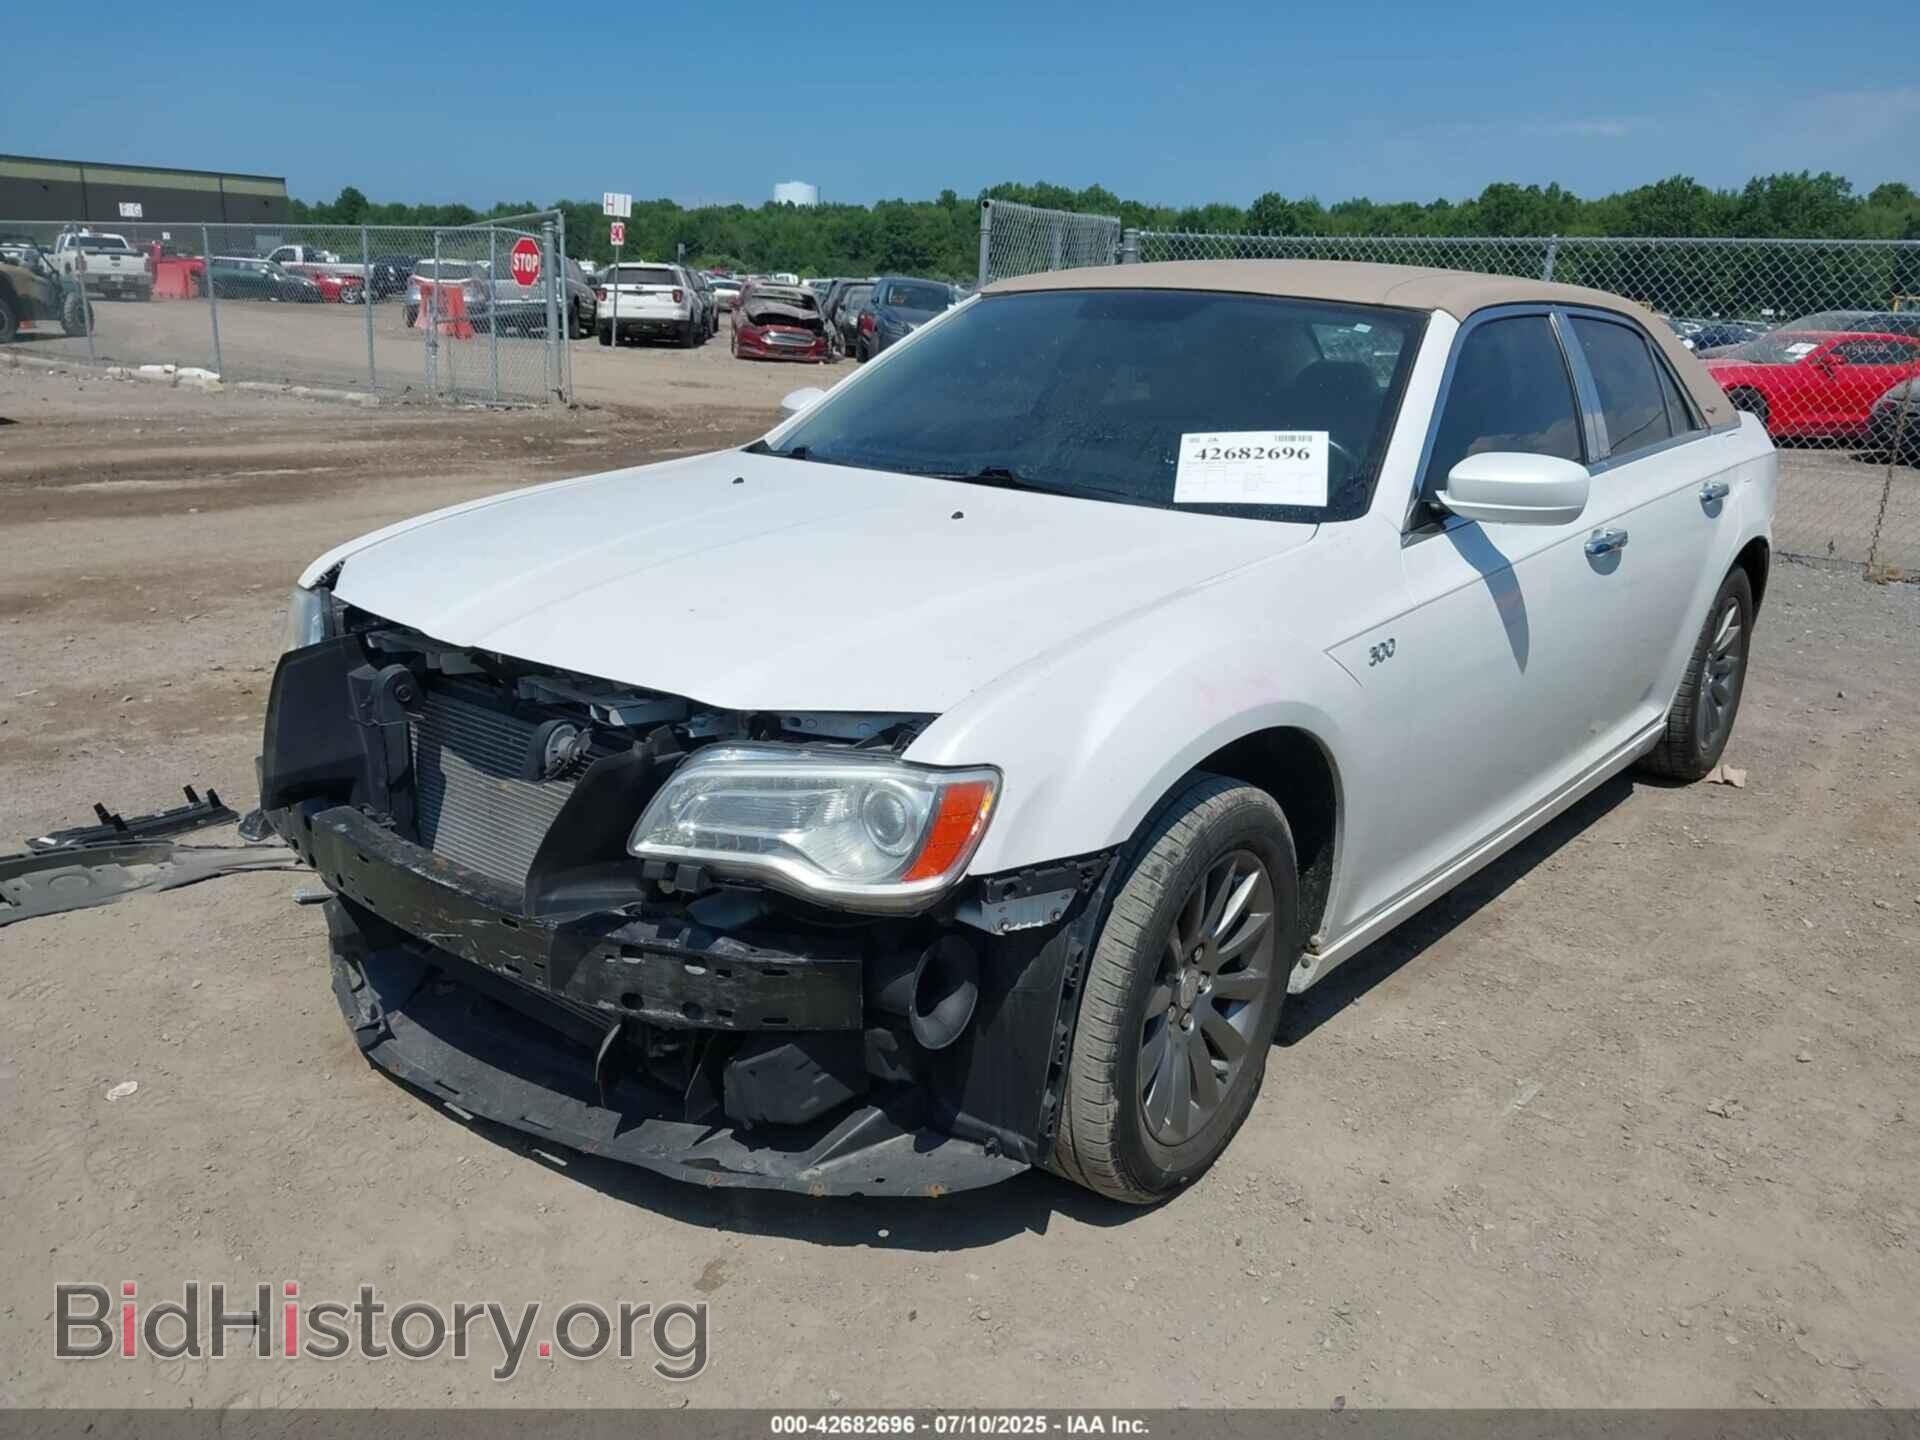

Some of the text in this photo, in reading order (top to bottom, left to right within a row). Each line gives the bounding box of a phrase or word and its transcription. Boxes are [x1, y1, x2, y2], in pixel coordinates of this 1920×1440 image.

[605, 193, 615, 214] H
[513, 252, 539, 273] STOP
[1195, 446, 1310, 461] 42682696
[1369, 637, 1396, 667] 300
